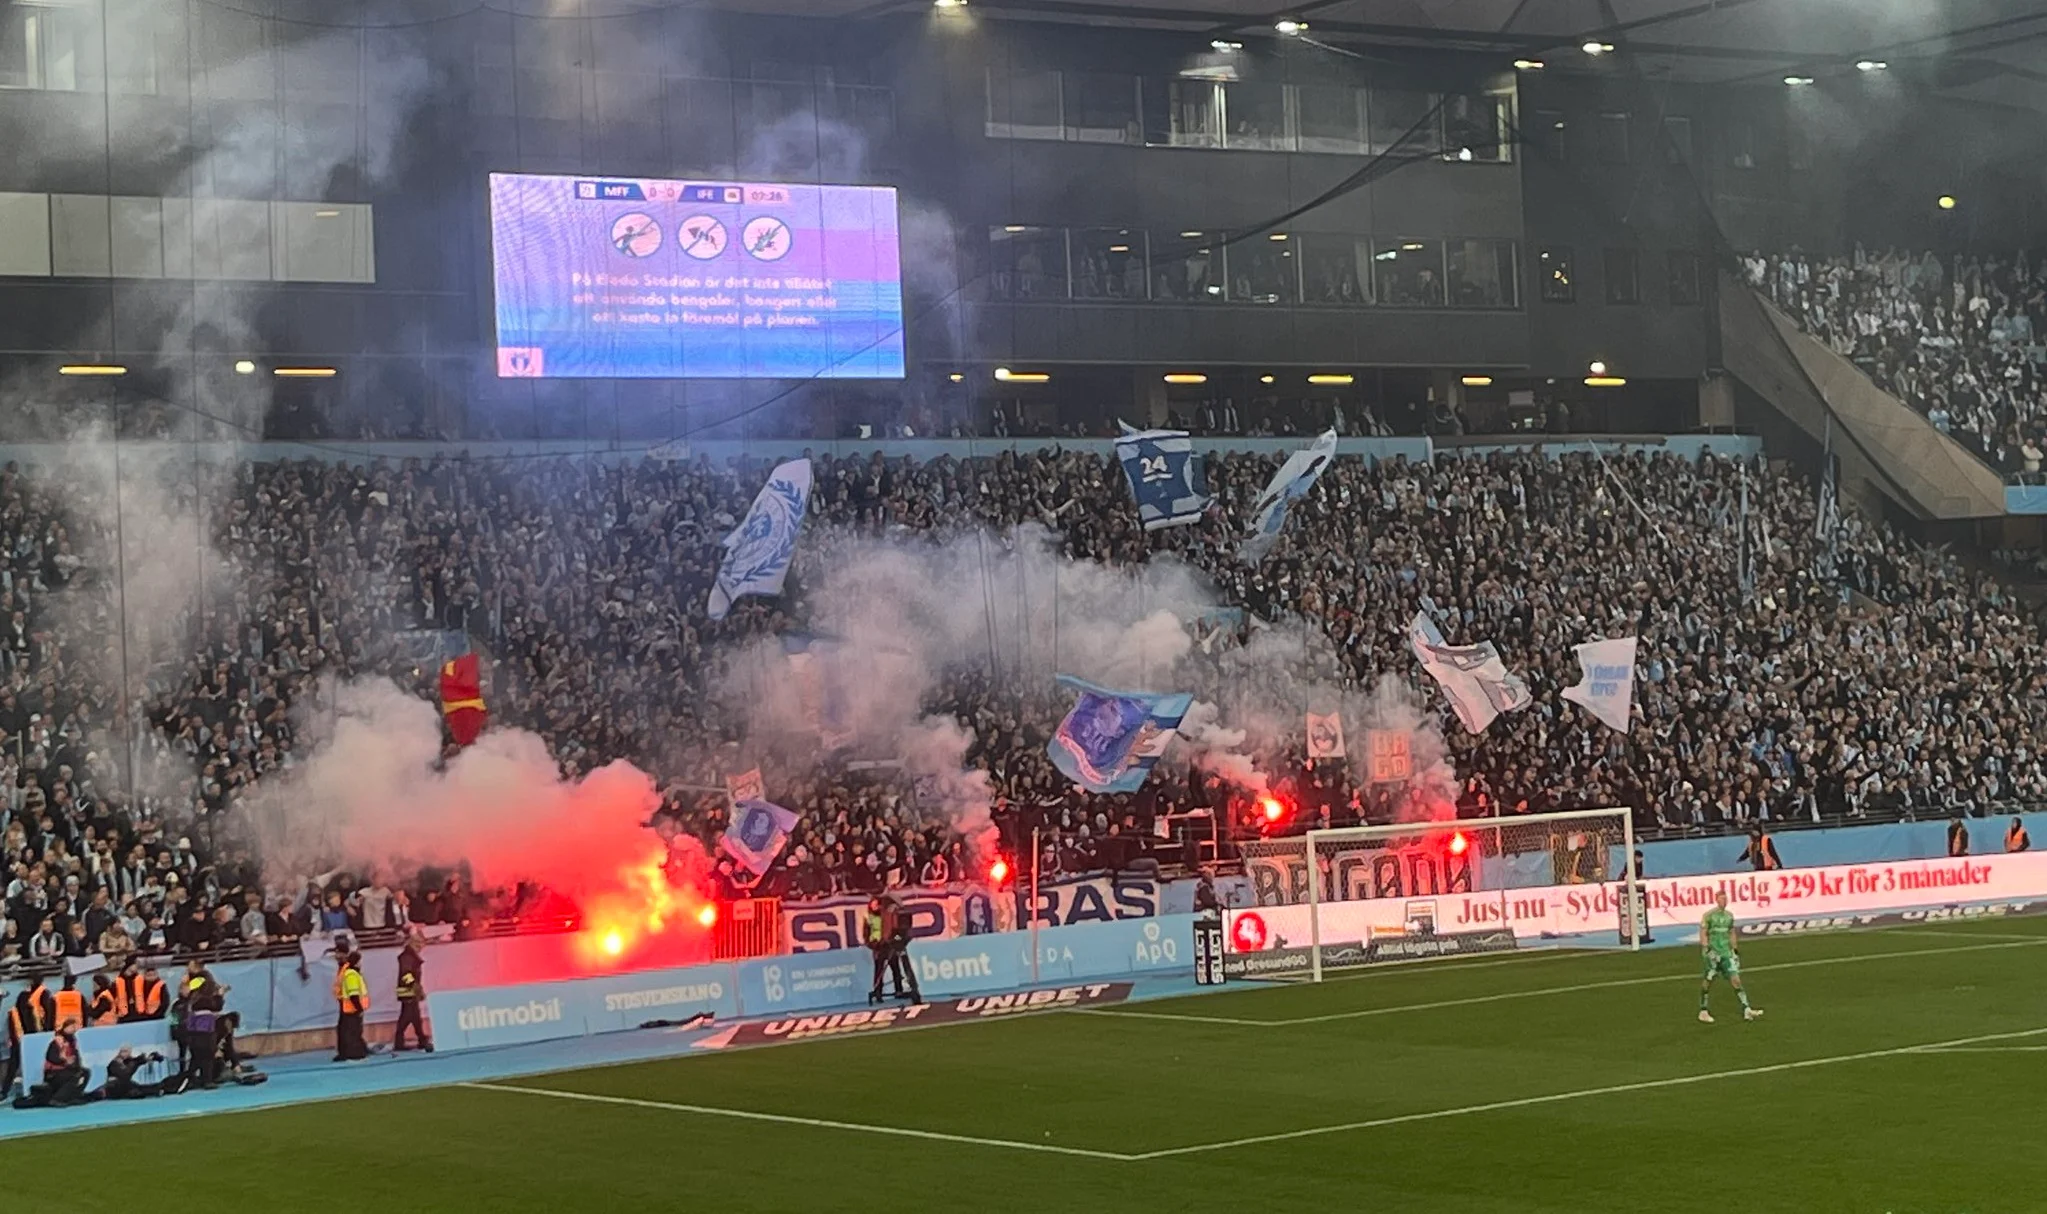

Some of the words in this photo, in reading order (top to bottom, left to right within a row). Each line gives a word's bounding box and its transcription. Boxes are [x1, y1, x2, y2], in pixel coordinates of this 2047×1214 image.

[603, 185, 630, 197] MFF
[1140, 455, 1168, 475] 24
[1456, 898, 1511, 924] Just
[1514, 897, 1546, 920] nu
[1566, 881, 1713, 921] Sydsnskan
[1717, 876, 1770, 908] Helg
[1777, 874, 1816, 901] 229
[1819, 871, 1844, 897] kr
[1848, 868, 1880, 895] för
[1884, 868, 1896, 891] 3
[1899, 861, 1992, 890] månader
[921, 953, 992, 982] bemt
[1195, 928, 1207, 984] SELECT
[1209, 927, 1224, 984] SELECT
[457, 997, 562, 1031] tillmobil
[956, 982, 1110, 1013] UNIBET
[763, 1003, 932, 1036] UNIBET
